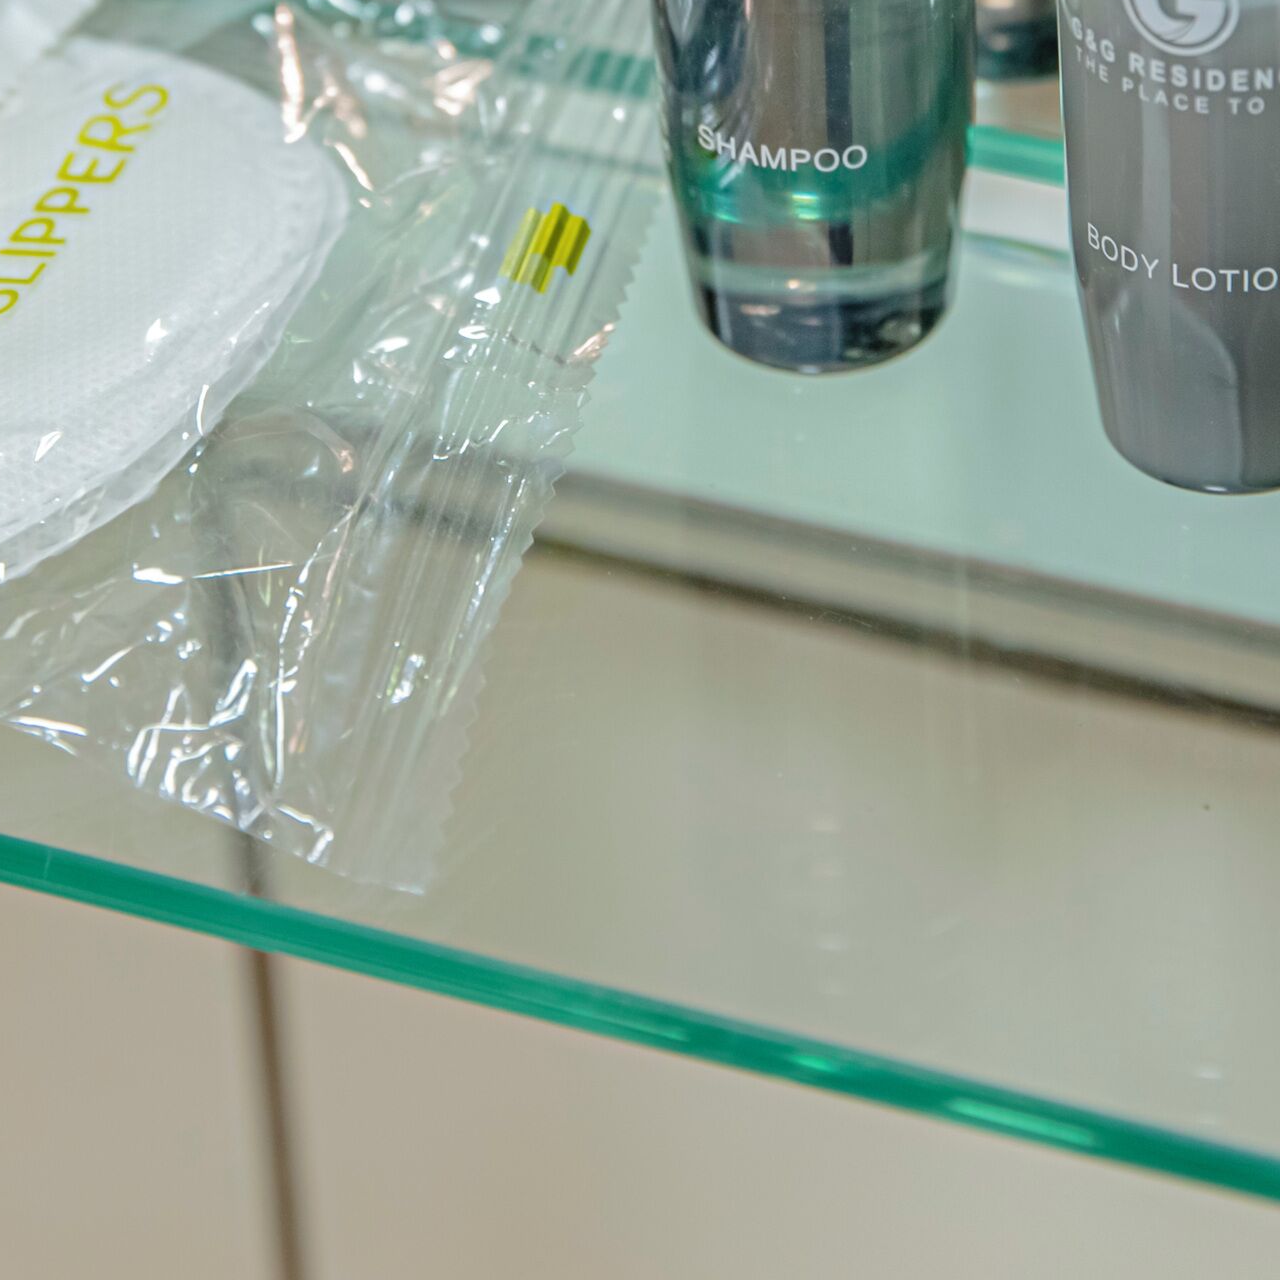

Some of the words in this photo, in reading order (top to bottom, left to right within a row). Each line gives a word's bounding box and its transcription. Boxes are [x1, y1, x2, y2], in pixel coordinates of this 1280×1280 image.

[1071, 17, 1115, 63] G&G
[1076, 46, 1109, 83] THE
[1122, 76, 1209, 114] PLACE
[1229, 97, 1264, 115] TO
[698, 124, 867, 172] SHAMPOO
[1088, 222, 1159, 278] BODY
